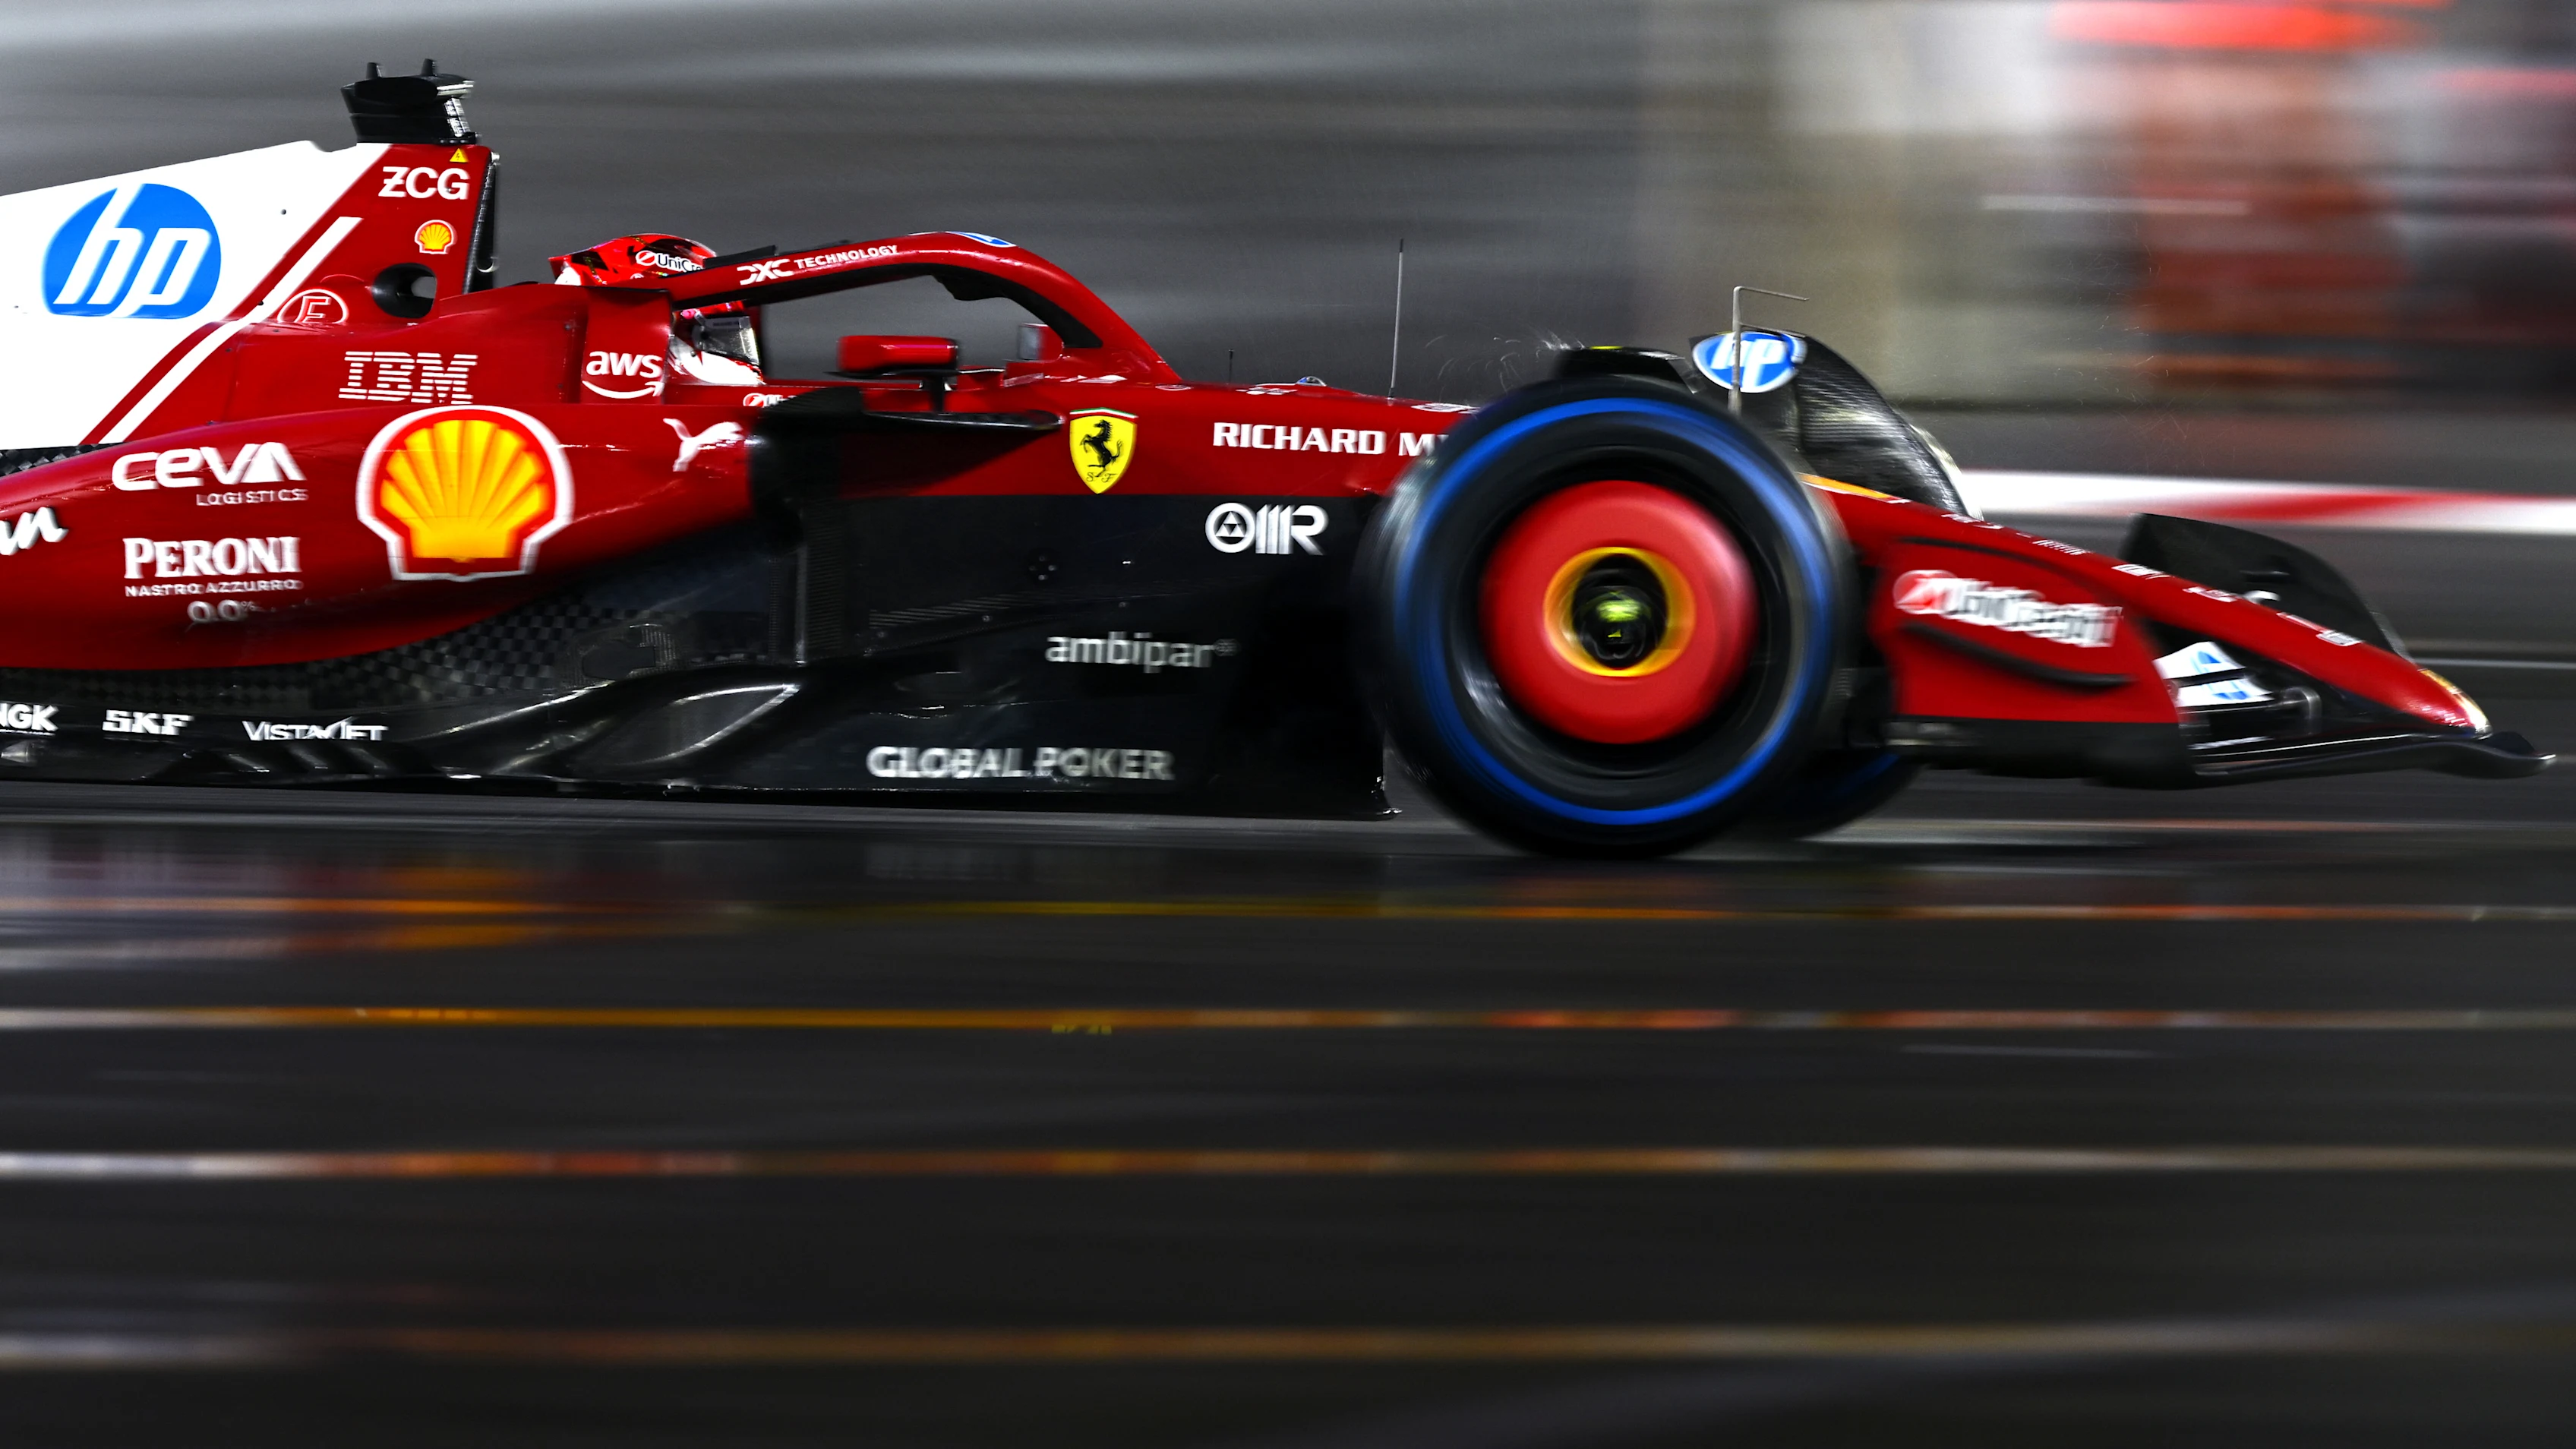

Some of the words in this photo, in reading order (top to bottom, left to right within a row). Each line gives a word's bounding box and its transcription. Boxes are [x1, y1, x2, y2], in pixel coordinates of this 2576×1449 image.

[52, 183, 213, 320] hp
[794, 245, 898, 269] TECHNOLOGY
[338, 352, 478, 405] IBM
[586, 350, 662, 377] aws
[1213, 422, 1387, 455] RICHARD
[196, 488, 308, 507] LOGISTICS
[123, 536, 301, 579] PERONI
[125, 583, 204, 597] NASTRO
[205, 579, 304, 594] AZZURRO
[102, 709, 194, 735] SKF
[866, 747, 1028, 778] GLOBAL
[1034, 748, 1175, 780] POKER
